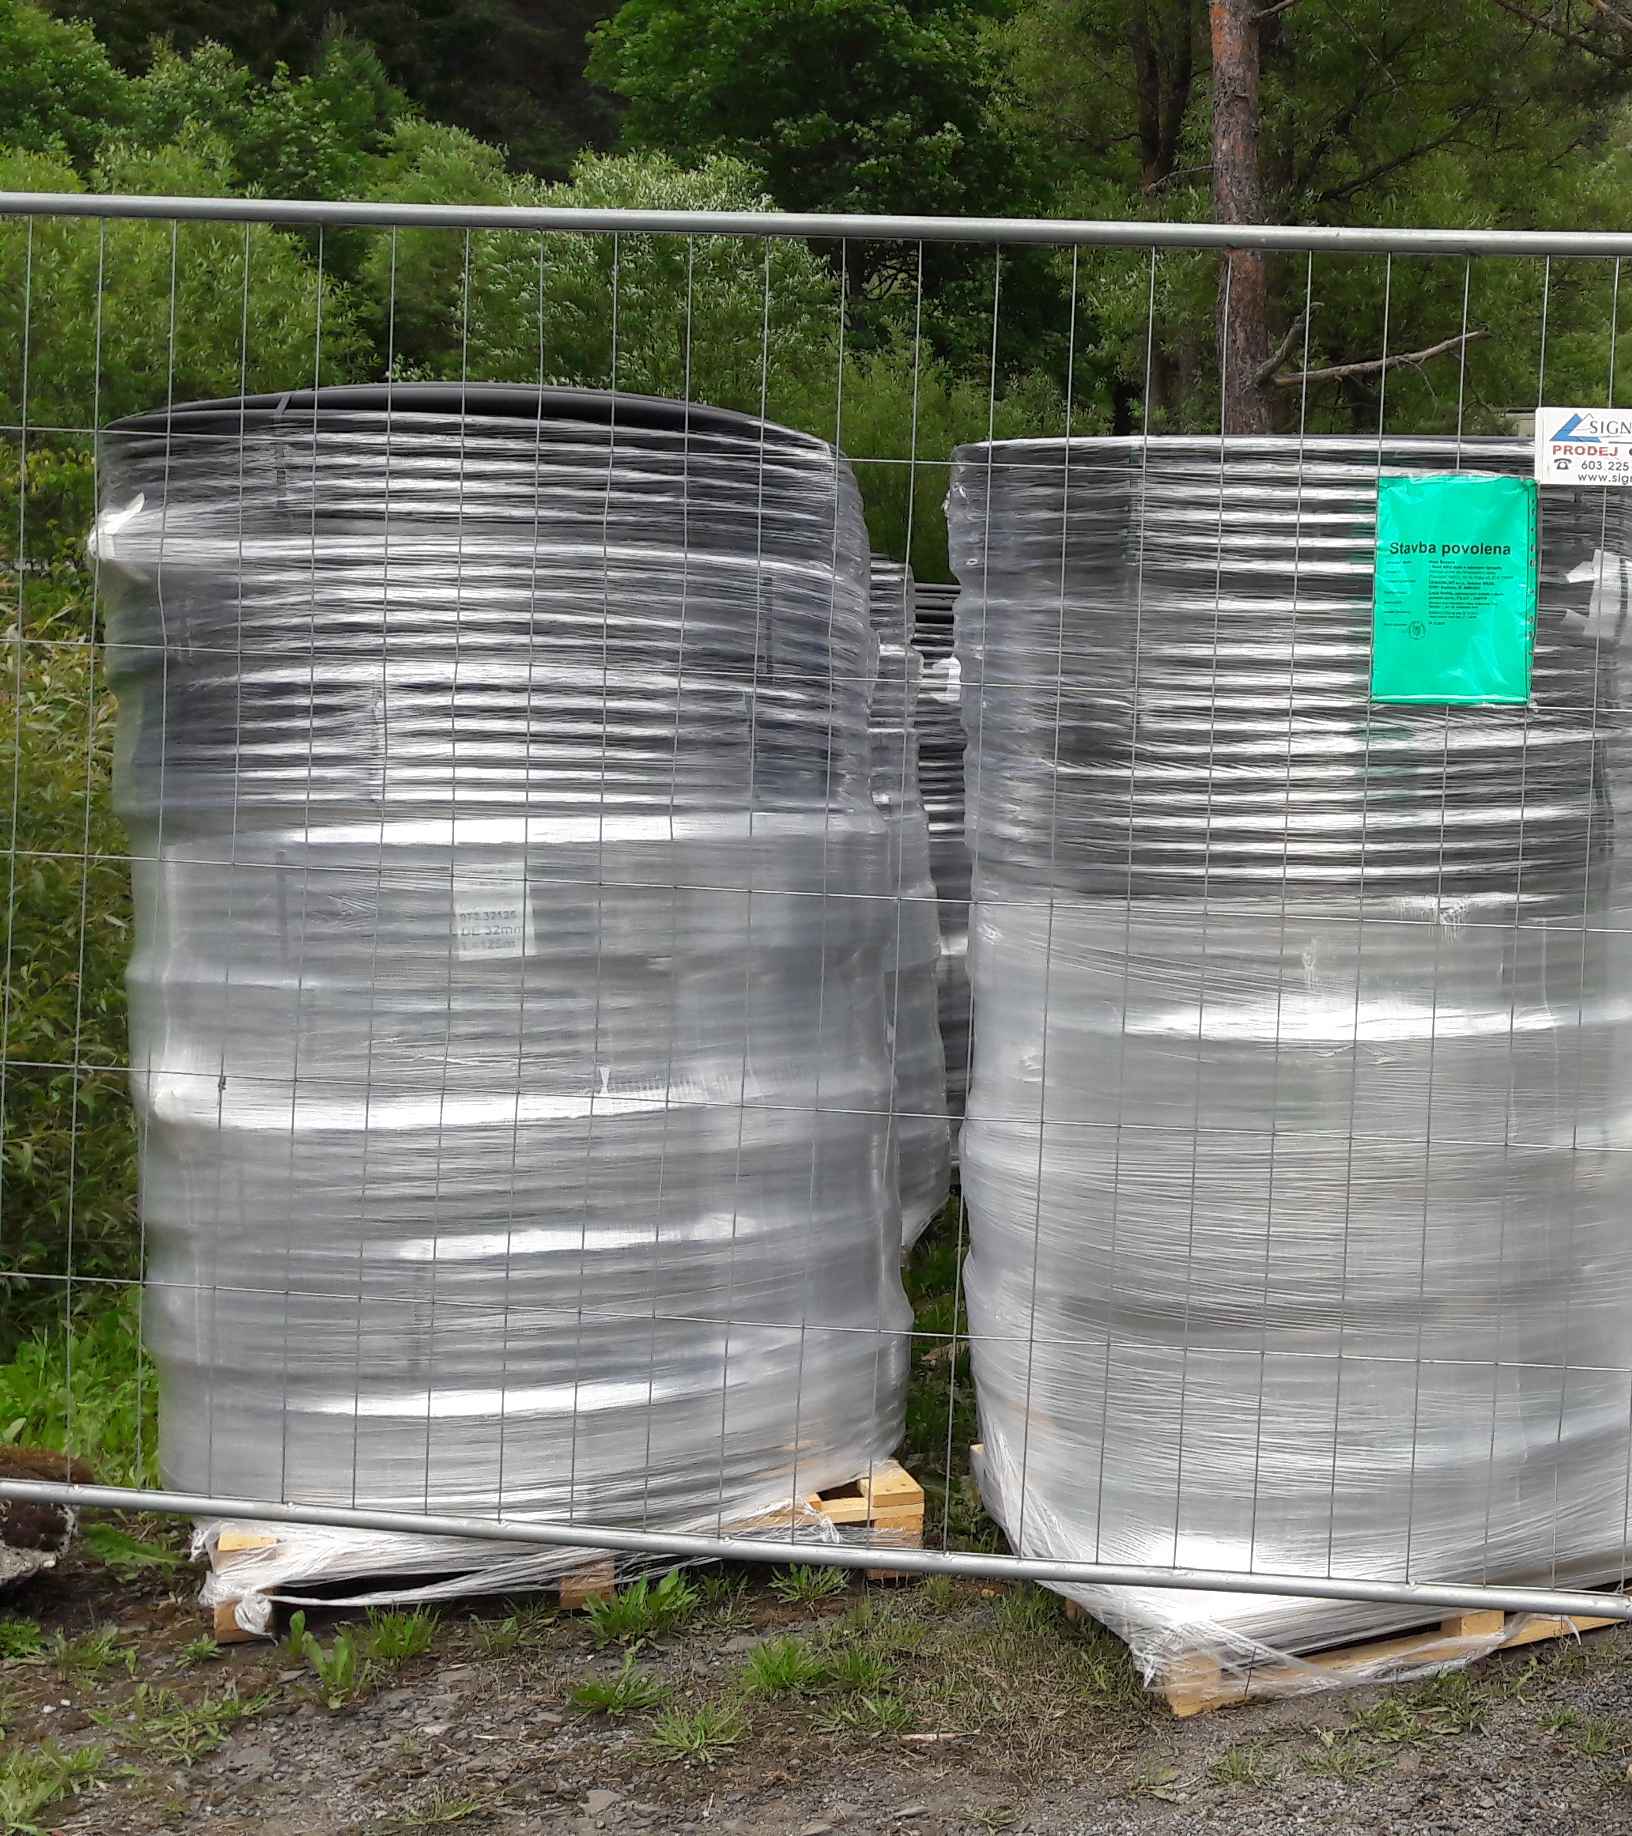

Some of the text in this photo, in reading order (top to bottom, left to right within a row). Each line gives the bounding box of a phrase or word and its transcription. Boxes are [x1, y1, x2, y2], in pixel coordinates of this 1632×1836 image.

[1552, 444, 1619, 457] PRODEJ
[1580, 460, 1603, 471] 603
[1607, 461, 1630, 471] 225
[1389, 541, 1511, 557] Stavba povolena
